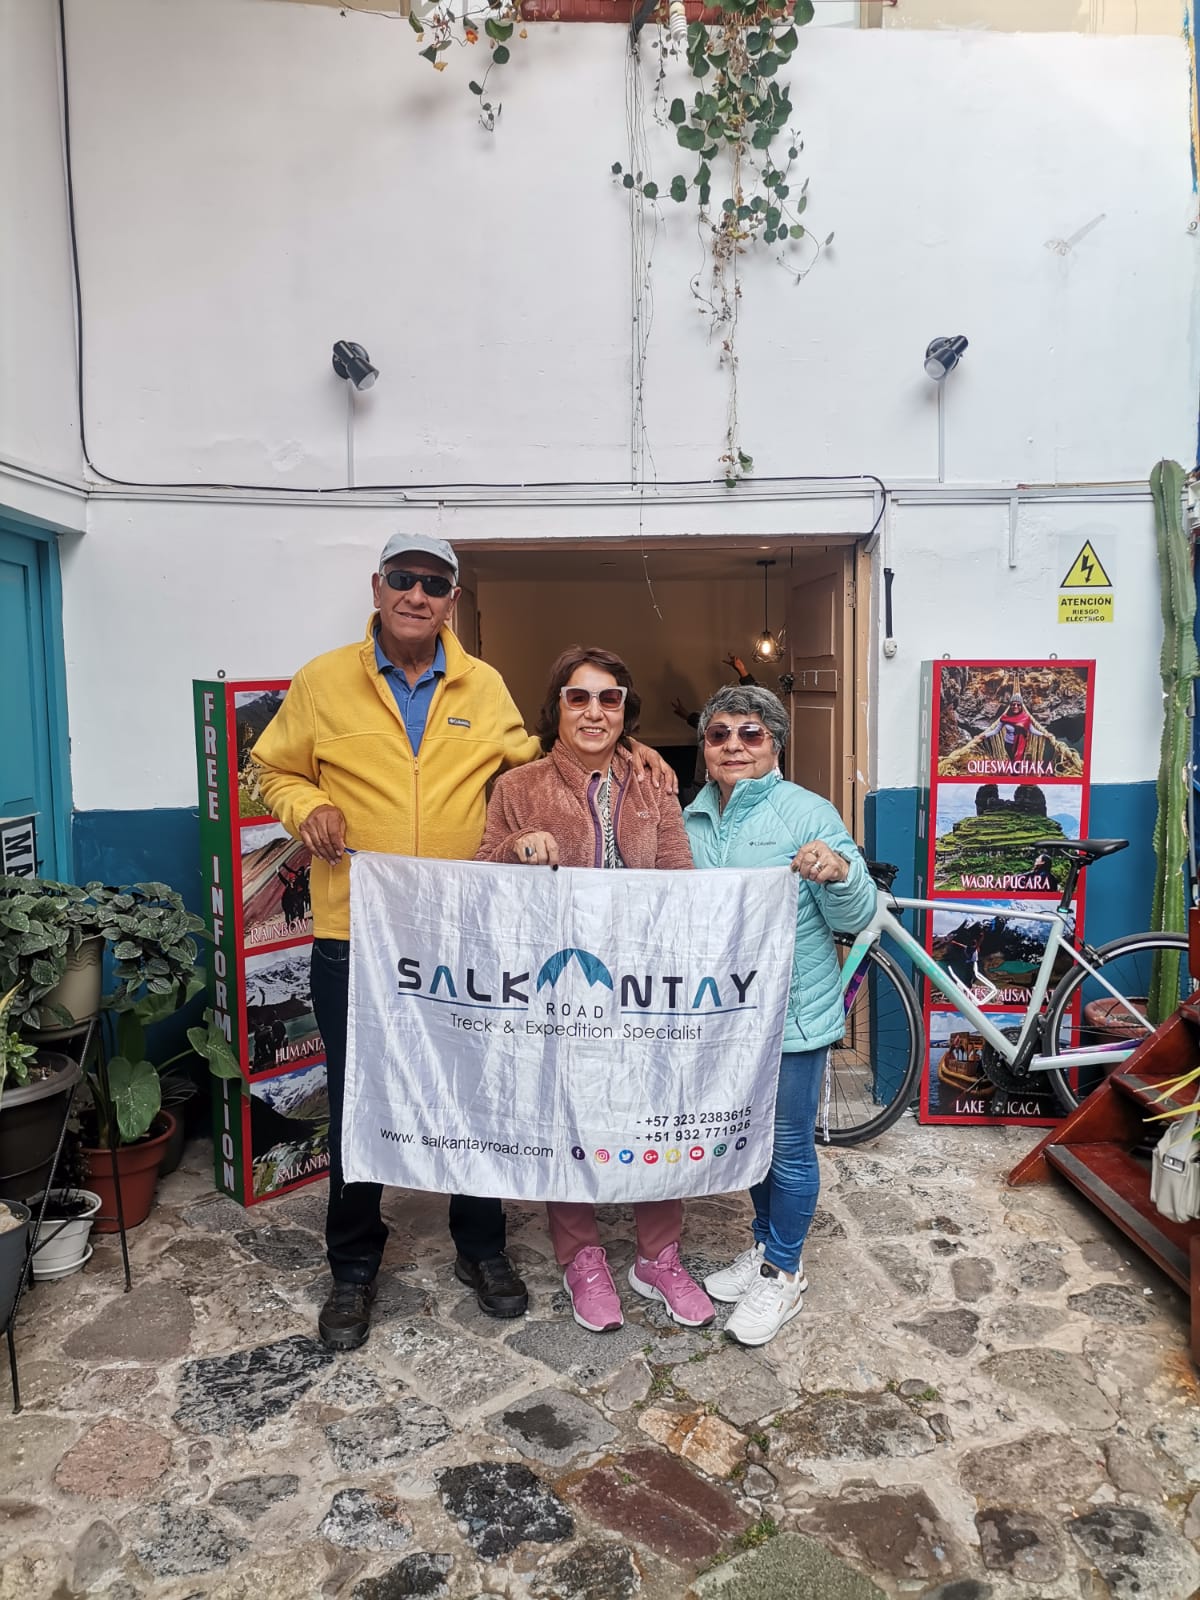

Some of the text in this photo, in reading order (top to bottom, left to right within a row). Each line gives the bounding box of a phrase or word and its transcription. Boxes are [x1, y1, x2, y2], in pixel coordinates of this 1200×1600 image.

[1060, 596, 1112, 606] ATENCIÓN
[967, 760, 1054, 774] QUESWACHAKA
[960, 874, 1051, 890] WAQRAPUCARA
[250, 918, 310, 945] RAINBOW
[203, 691, 236, 1193] FREE INFORMTION
[546, 1002, 604, 1019] ROAD
[450, 1013, 703, 1041] Treck & Expedition Specialist
[645, 1116, 669, 1127] +57
[673, 1114, 696, 1127] 323
[700, 1106, 752, 1124] 2383615
[955, 1100, 985, 1114] LAKE
[645, 1131, 670, 1142] +51
[675, 1129, 700, 1142] 932
[705, 1119, 751, 1139] 771926
